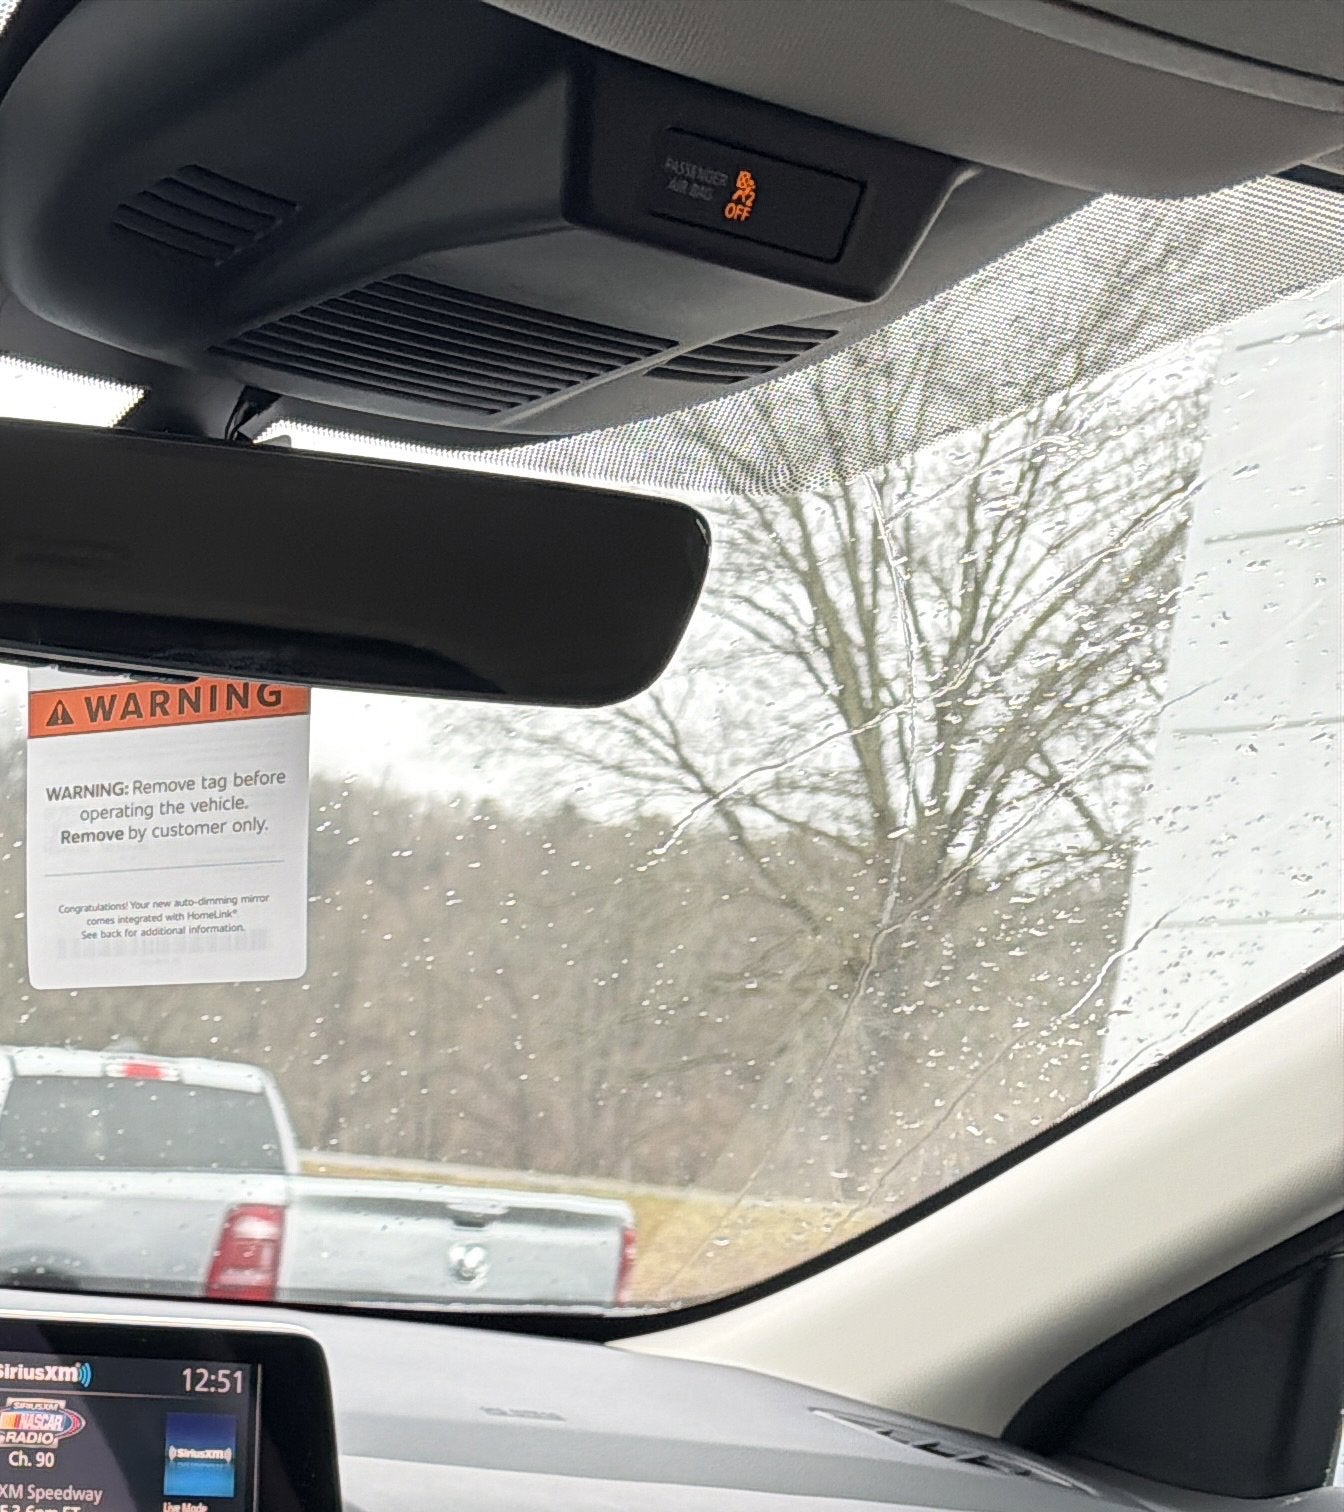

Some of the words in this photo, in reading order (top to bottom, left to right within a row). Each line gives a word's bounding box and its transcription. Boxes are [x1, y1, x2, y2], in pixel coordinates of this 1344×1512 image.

[724, 202, 751, 221] OFF
[84, 683, 282, 723] WARNING
[46, 783, 129, 801] WARNING:
[132, 779, 195, 796] Remove
[201, 776, 227, 792] tag
[233, 769, 286, 787] before
[80, 802, 153, 823] operating
[159, 798, 185, 815] the
[191, 796, 249, 813] vehicle.
[61, 826, 124, 844] Remove
[128, 824, 147, 843] by
[152, 821, 226, 838] customer
[232, 817, 269, 834] only.
[58, 901, 128, 914] Congratulations!
[129, 901, 151, 911] Your
[152, 900, 171, 909] new
[174, 895, 238, 908] auto-dimming
[241, 894, 270, 904] mirror
[86, 917, 115, 926] comes
[118, 913, 163, 925] integrated
[166, 911, 185, 922] with
[81, 930, 97, 940] See
[100, 928, 122, 939] back
[124, 928, 138, 938] for
[140, 925, 186, 937] additional
[182, 1368, 243, 1394] 12:51
[21, 1413, 64, 1431] NASCAR
[9, 1450, 32, 1467] Ch.
[36, 1452, 55, 1468] 90
[28, 1484, 103, 1505] Speedway
